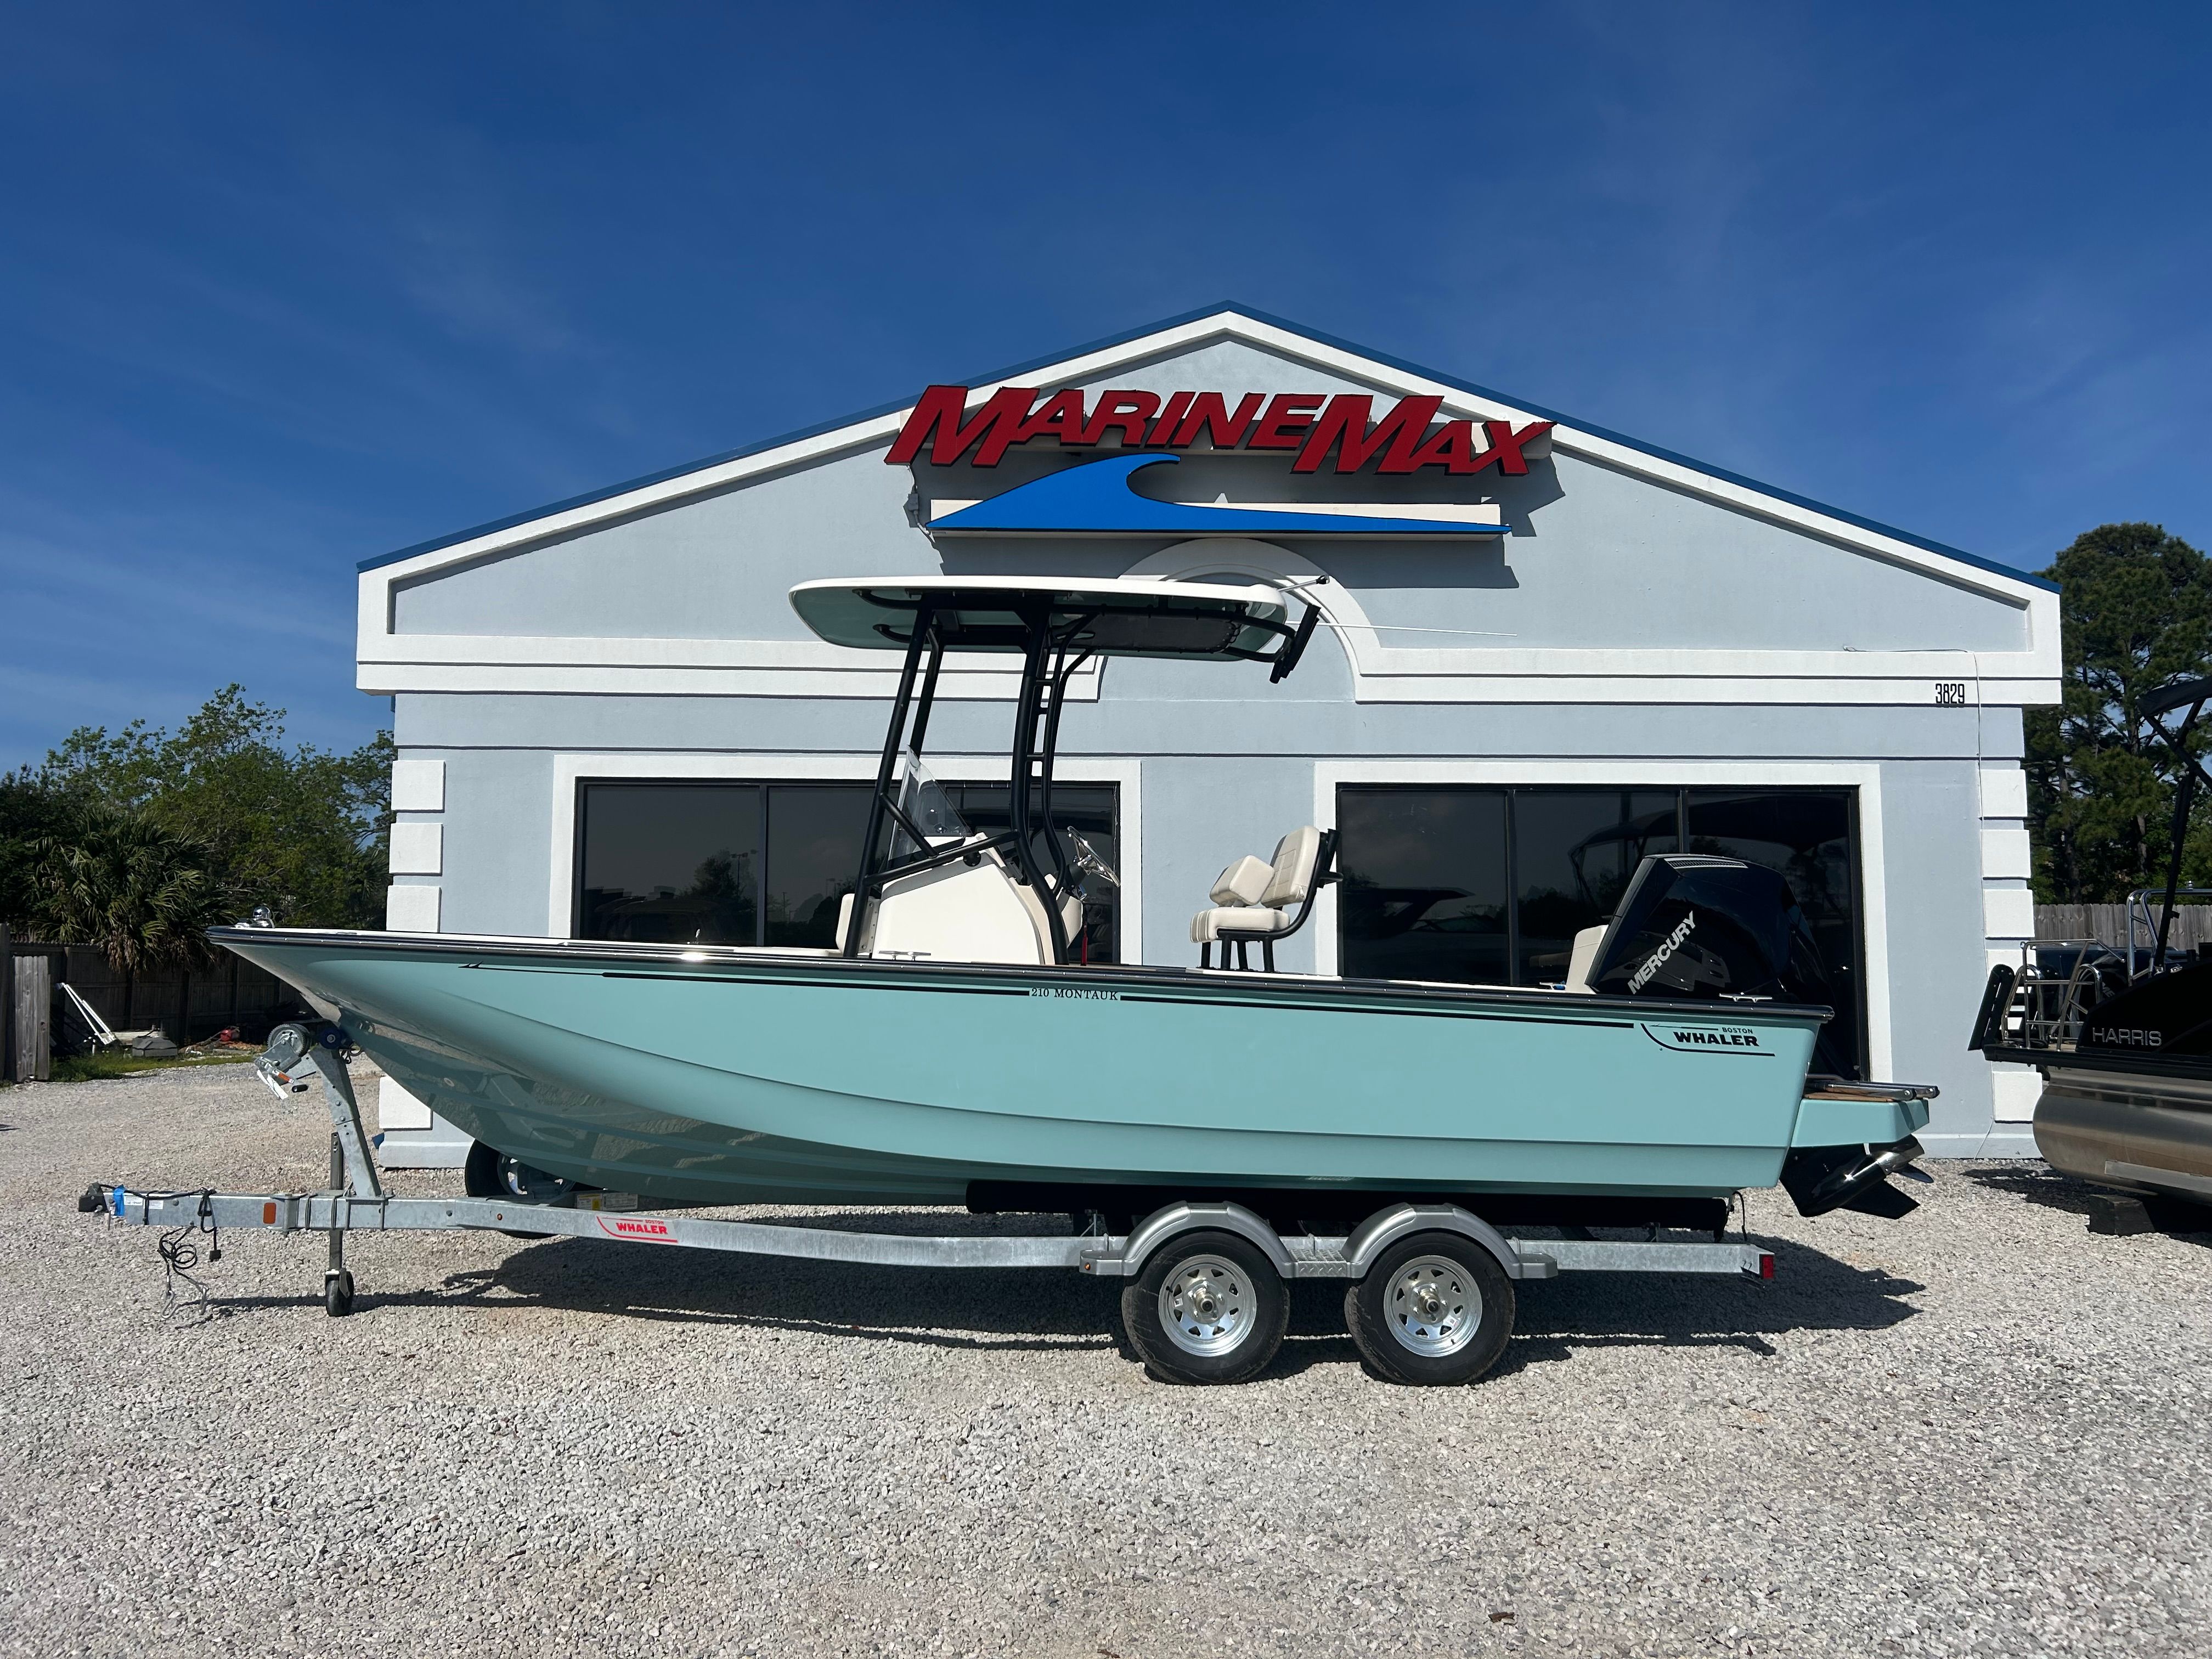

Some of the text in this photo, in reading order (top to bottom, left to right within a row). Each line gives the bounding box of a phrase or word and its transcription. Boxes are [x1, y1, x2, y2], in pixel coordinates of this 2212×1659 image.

[1935, 683, 1965, 704] 3829
[1627, 911, 1696, 994] MERCURY
[1031, 988, 1118, 1001] 210 MONTAUK
[1673, 1031, 1759, 1047] WHALER
[2092, 1027, 2162, 1046] HARRIS
[616, 1222, 668, 1235] WHALER
